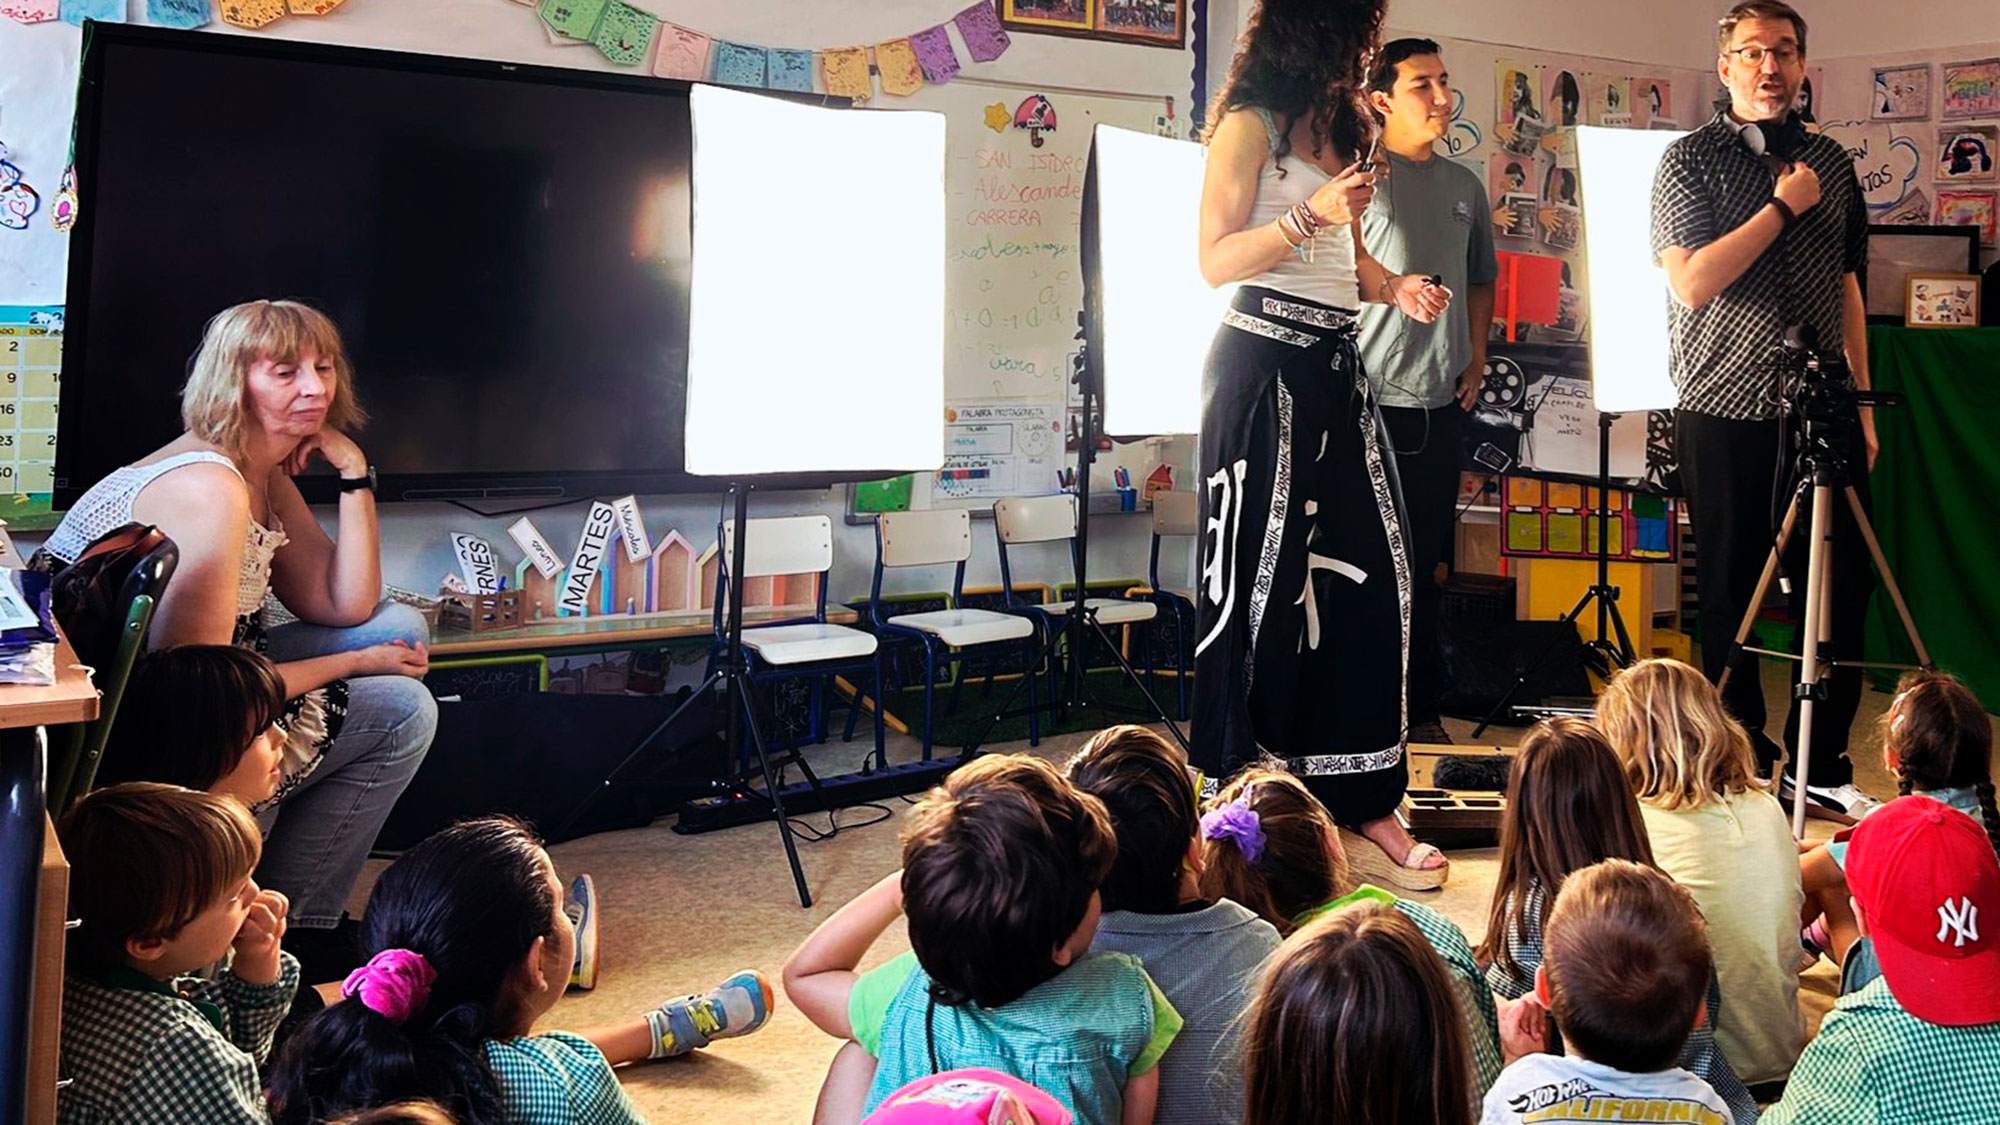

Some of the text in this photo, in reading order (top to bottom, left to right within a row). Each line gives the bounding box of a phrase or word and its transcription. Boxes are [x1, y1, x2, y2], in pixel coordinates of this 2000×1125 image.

[975, 149, 1085, 174] SAN ISIDRO
[966, 208, 1041, 226] CARRERA
[9, 341, 19, 352] 2
[7, 372, 17, 383] 9
[0, 404, 15, 415] 16
[562, 506, 613, 607] MARTES
[1936, 896, 1979, 947] NY
